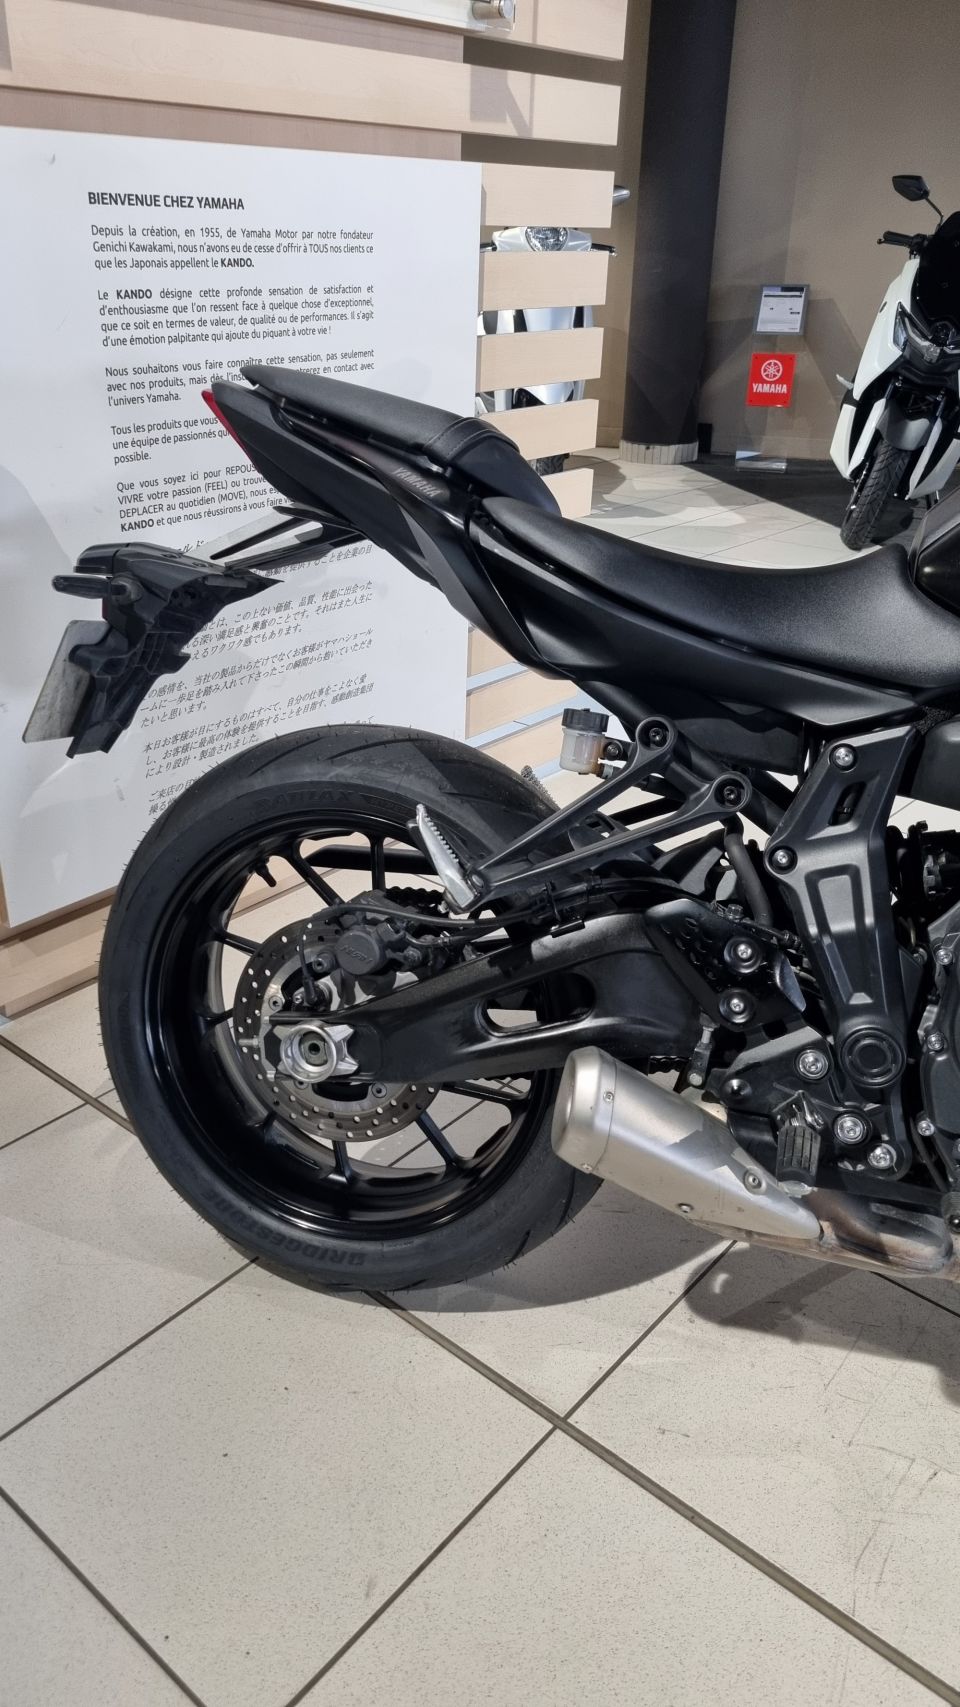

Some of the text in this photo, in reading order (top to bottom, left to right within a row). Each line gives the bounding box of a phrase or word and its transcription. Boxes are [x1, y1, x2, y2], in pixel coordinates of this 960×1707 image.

[88, 192, 244, 210] BIENVENUE CHEZ YAMAHA
[91, 225, 373, 240] Depuis la création, en 1955, de Yamaha Motor par notre fondateur
[93, 241, 127, 252] Genichi
[129, 241, 176, 254] Kawakami,
[178, 244, 198, 253] nous
[200, 242, 229, 253] n'avons
[242, 242, 252, 253] de
[254, 245, 274, 253] cesse
[276, 242, 302, 253] d'offrir
[303, 243, 307, 253] à
[309, 244, 328, 253] TOUS
[343, 243, 365, 253] clients
[95, 257, 254, 270] que les Japonais appellent le KANDO.
[98, 284, 374, 300] Le KANDO désigne cette profonde sensation de satisfaction et
[100, 304, 168, 316] d'enthousiasme
[172, 305, 188, 315] que
[192, 302, 206, 312] l'on
[210, 302, 239, 312] ressent
[242, 300, 258, 311] face
[262, 300, 266, 310] à
[269, 300, 298, 312] quelque
[301, 299, 321, 308] chose
[101, 323, 118, 333] que
[121, 322, 131, 330] ce
[134, 319, 150, 330] soit
[152, 321, 163, 329] en
[166, 319, 195, 328] termes
[198, 317, 208, 327] de
[210, 316, 236, 327] valeur,
[238, 315, 248, 325] de
[250, 314, 276, 327] qualité
[290, 313, 298, 323] de
[357, 310, 374, 321] s'agit
[102, 336, 128, 347] d'une
[130, 334, 166, 345] émotion
[168, 332, 209, 346] palpitante
[211, 331, 223, 343] qui
[225, 330, 249, 342] ajoute
[251, 328, 261, 339] du
[263, 328, 290, 340] piquant
[292, 327, 296, 336] à
[297, 327, 316, 336] votre
[317, 326, 327, 334] vie
[105, 367, 128, 376] Nous
[132, 363, 178, 375] souhaitons
[182, 363, 201, 371] vous
[205, 360, 223, 370] faire
[266, 356, 284, 365] cette
[288, 353, 322, 363] sensation,
[326, 353, 338, 362] pas
[341, 349, 374, 359] seulement
[107, 383, 127, 392] avec
[130, 382, 146, 390] nos
[149, 377, 186, 390] produits,
[189, 374, 207, 385] mais
[334, 363, 358, 372] contact
[108, 391, 181, 406] l'univers Yamaha.
[752, 383, 788, 394] YAMAHA
[110, 418, 218, 435] Tous les produits que vous
[113, 441, 129, 450] une
[131, 436, 160, 448] équipe
[161, 434, 171, 444] de
[173, 429, 216, 444] passionnés
[114, 450, 152, 466] possible.
[117, 482, 134, 493] Que
[139, 479, 159, 488] vous
[163, 475, 186, 486] soyez
[190, 471, 198, 480] ici
[204, 470, 221, 480] pour
[392, 467, 441, 497] YAMAHA
[118, 493, 144, 505] VIVRE
[147, 491, 168, 500] votre
[172, 485, 201, 499] passion
[205, 480, 228, 493] (FEEL)
[120, 504, 164, 518] DEPLACER
[179, 496, 215, 510] quotidien
[218, 489, 248, 504] (MOVE),
[250, 488, 267, 497] nous
[121, 518, 154, 532] KANDO
[156, 517, 165, 526] et
[167, 516, 182, 525] que
[184, 512, 202, 521] nous
[204, 505, 242, 518] réussirons
[243, 502, 247, 511] à
[249, 501, 265, 510] vous
[266, 497, 282, 508] faire
[202, 580, 372, 630] とは、この上ない価値、品質、性能に出会った
[146, 628, 373, 698] の感情を、当社の製品からだけでなくお客様がヤマハショール
